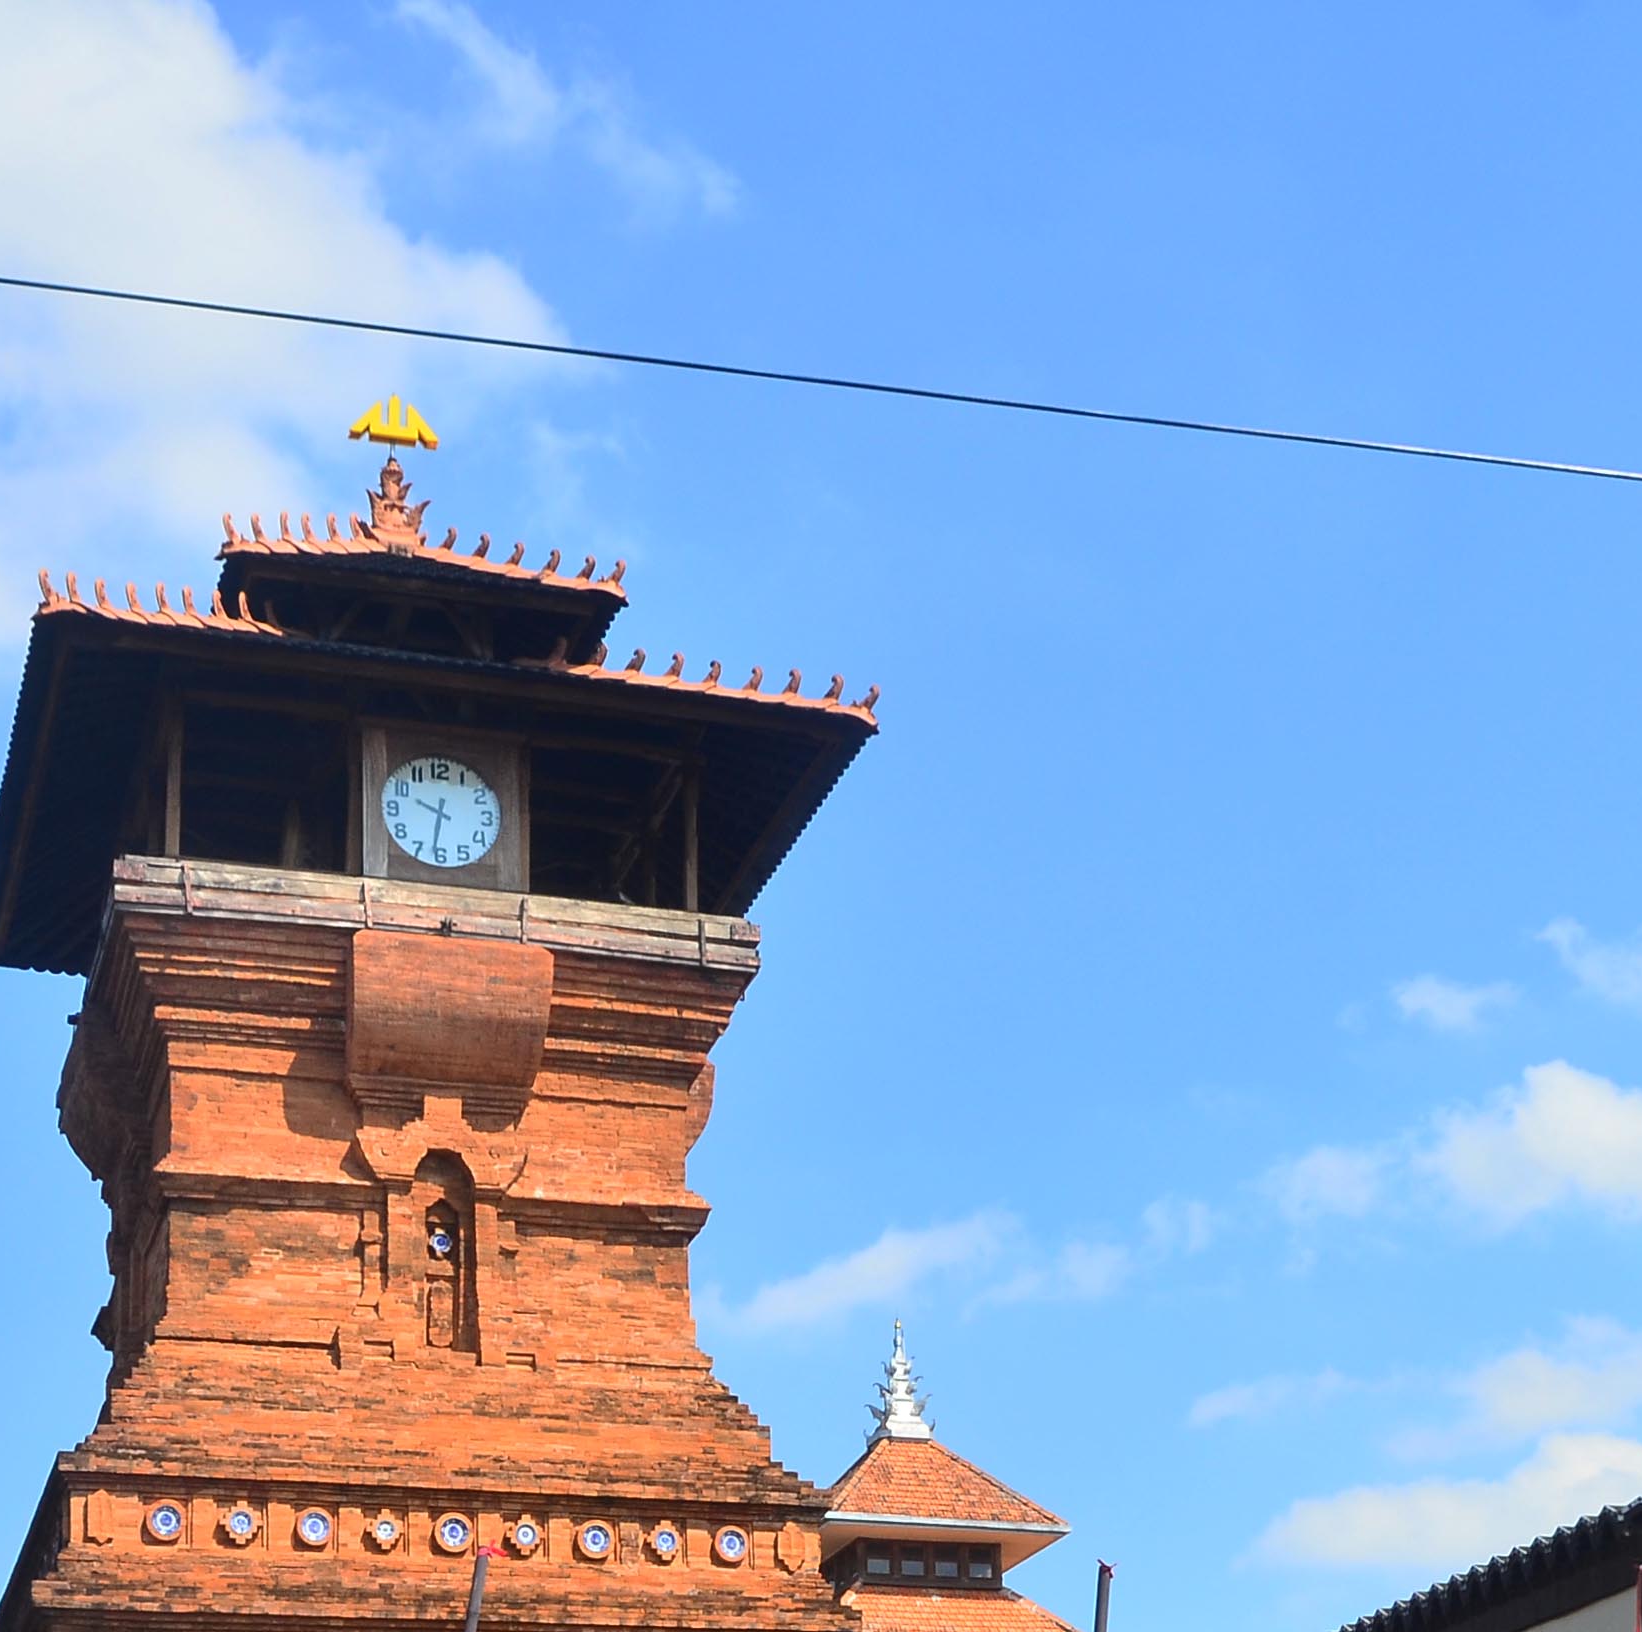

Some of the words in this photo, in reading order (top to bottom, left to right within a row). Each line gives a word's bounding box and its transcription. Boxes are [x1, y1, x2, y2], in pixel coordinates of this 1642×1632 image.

[412, 766, 423, 783] 11
[431, 763, 449, 780] 12
[395, 780, 409, 797] 10
[474, 788, 487, 805] 2
[387, 800, 399, 817] 9
[481, 811, 493, 827] 3
[394, 823, 407, 839] 8
[473, 830, 486, 848] 4
[412, 841, 423, 857] 7
[434, 848, 447, 864] 6
[457, 845, 470, 862] 5
